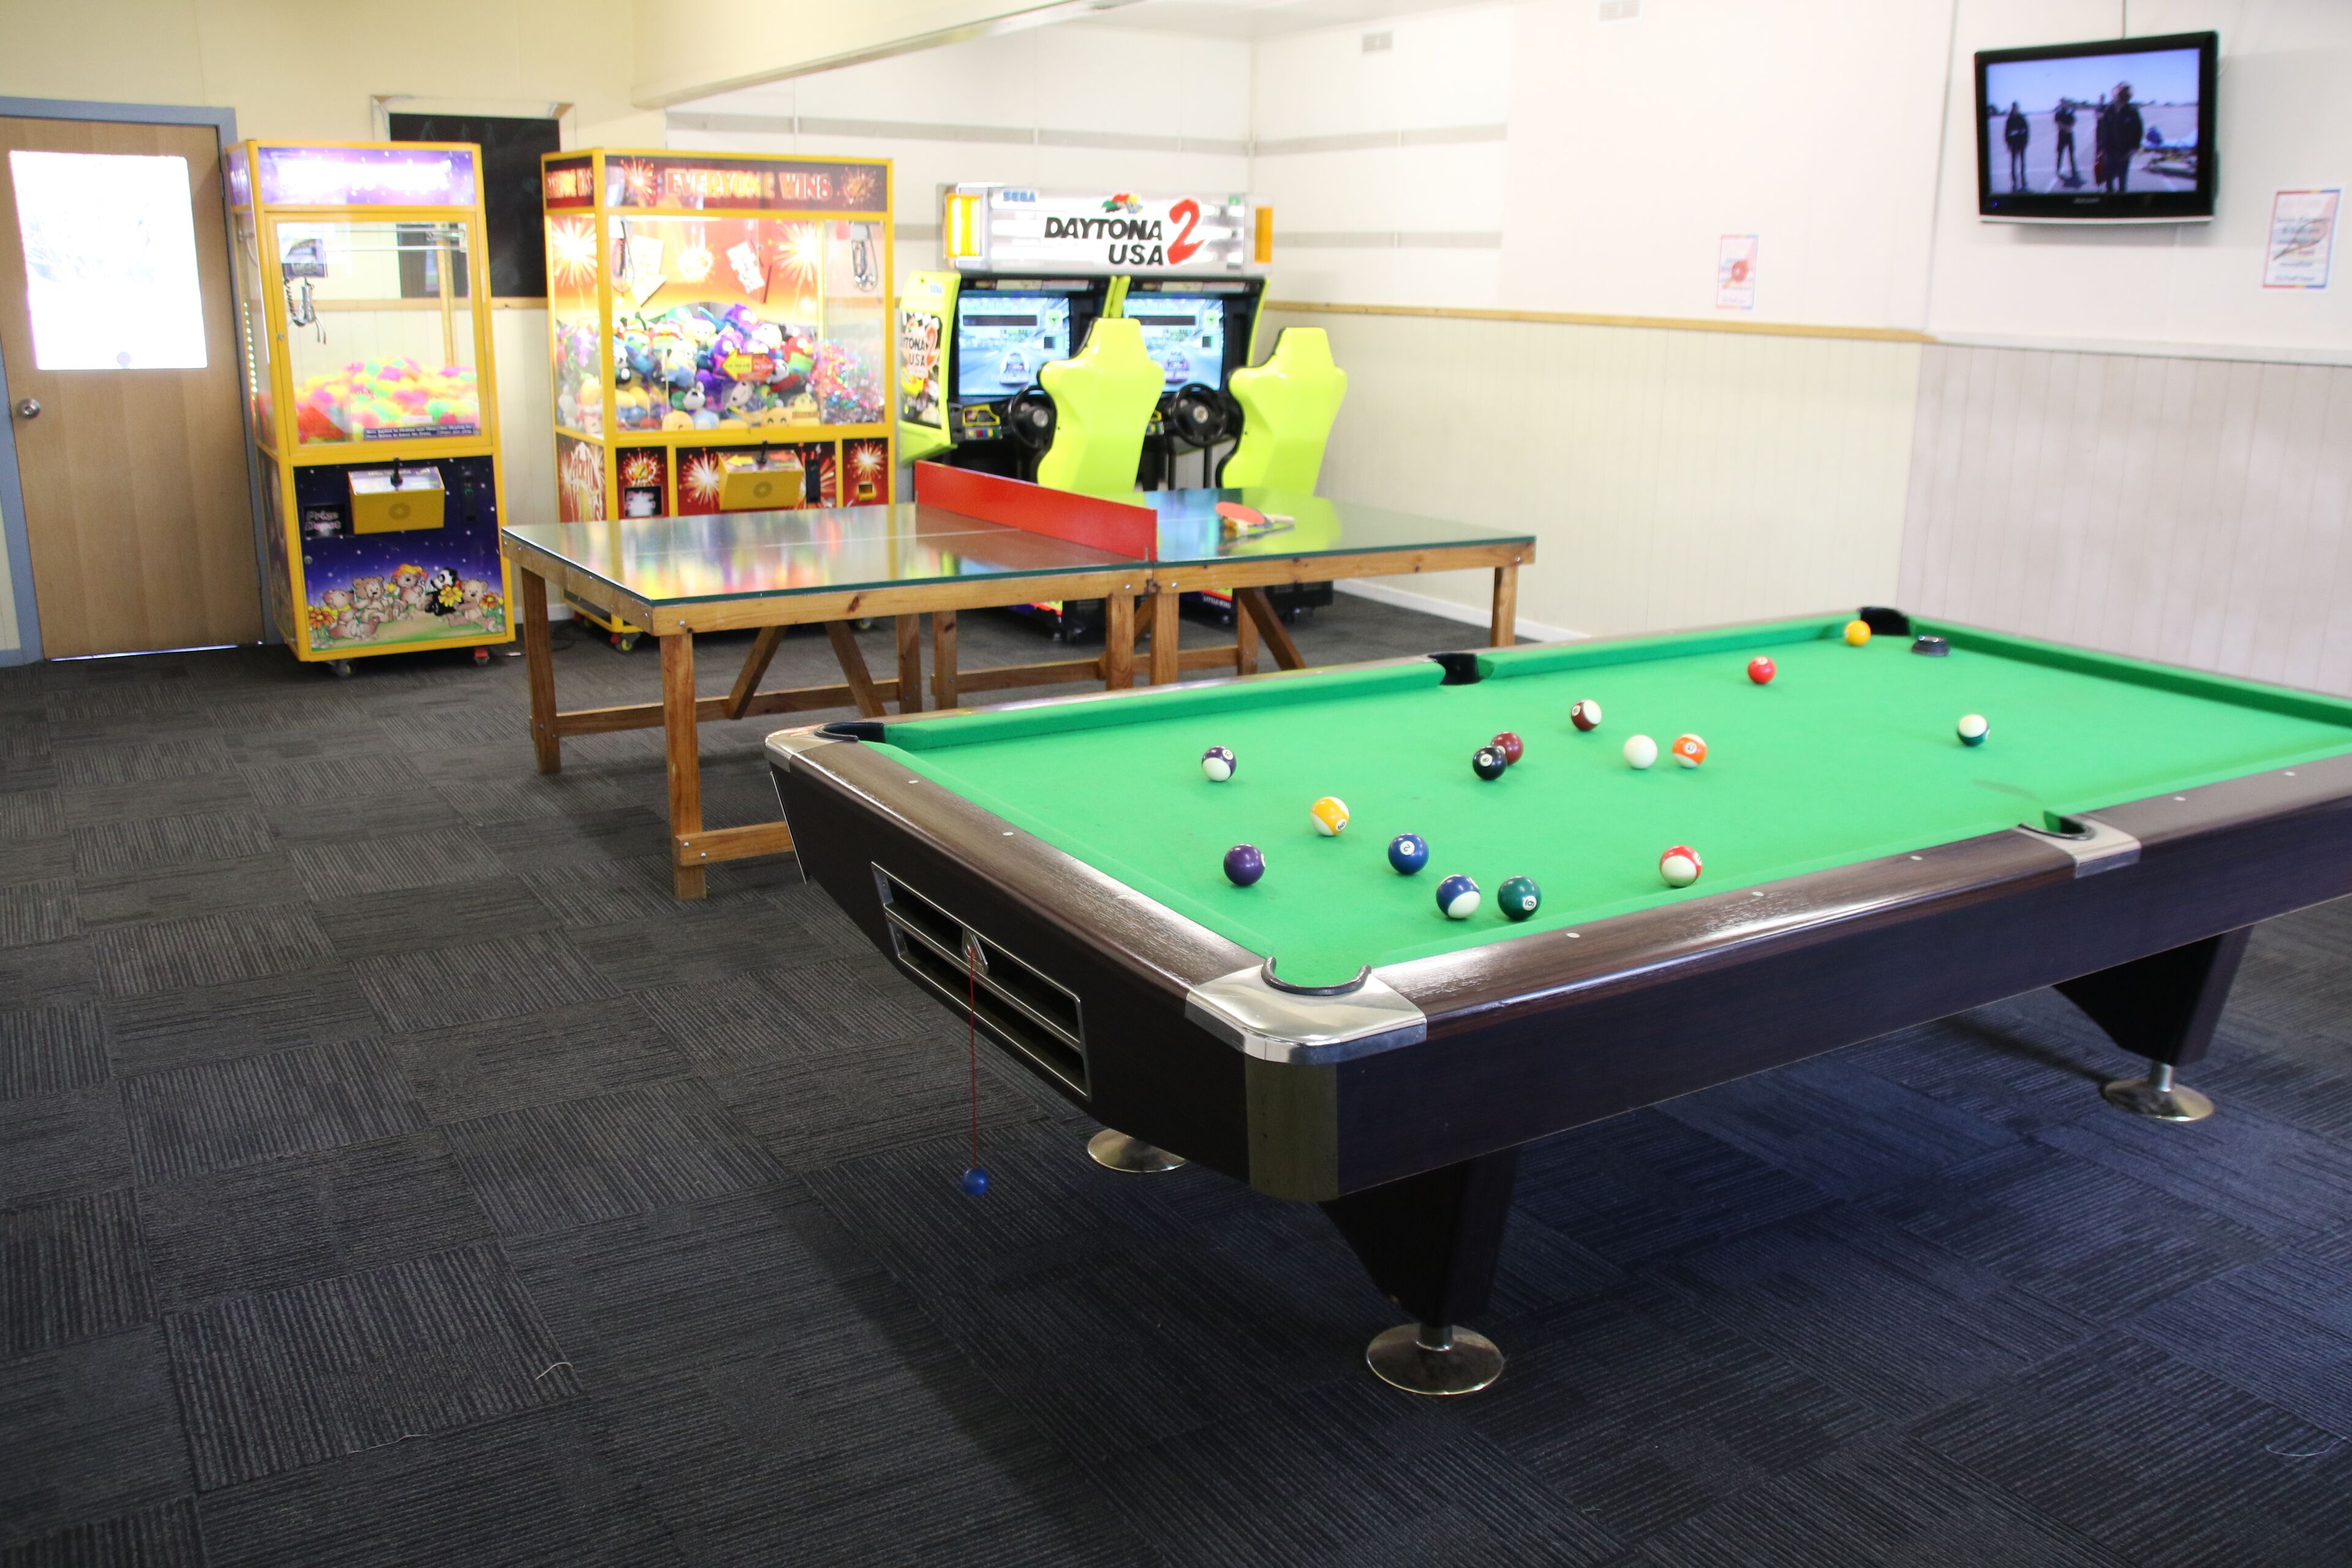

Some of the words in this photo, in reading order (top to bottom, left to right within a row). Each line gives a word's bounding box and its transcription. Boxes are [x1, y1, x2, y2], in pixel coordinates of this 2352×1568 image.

[665, 168, 775, 198] EVERYONE
[778, 172, 832, 200] WINS
[1003, 192, 1036, 202] SEGA
[1044, 217, 1163, 241] DAYTONA
[1167, 198, 1207, 265] 2
[1109, 244, 1163, 265] USA
[909, 353, 925, 367] USA
